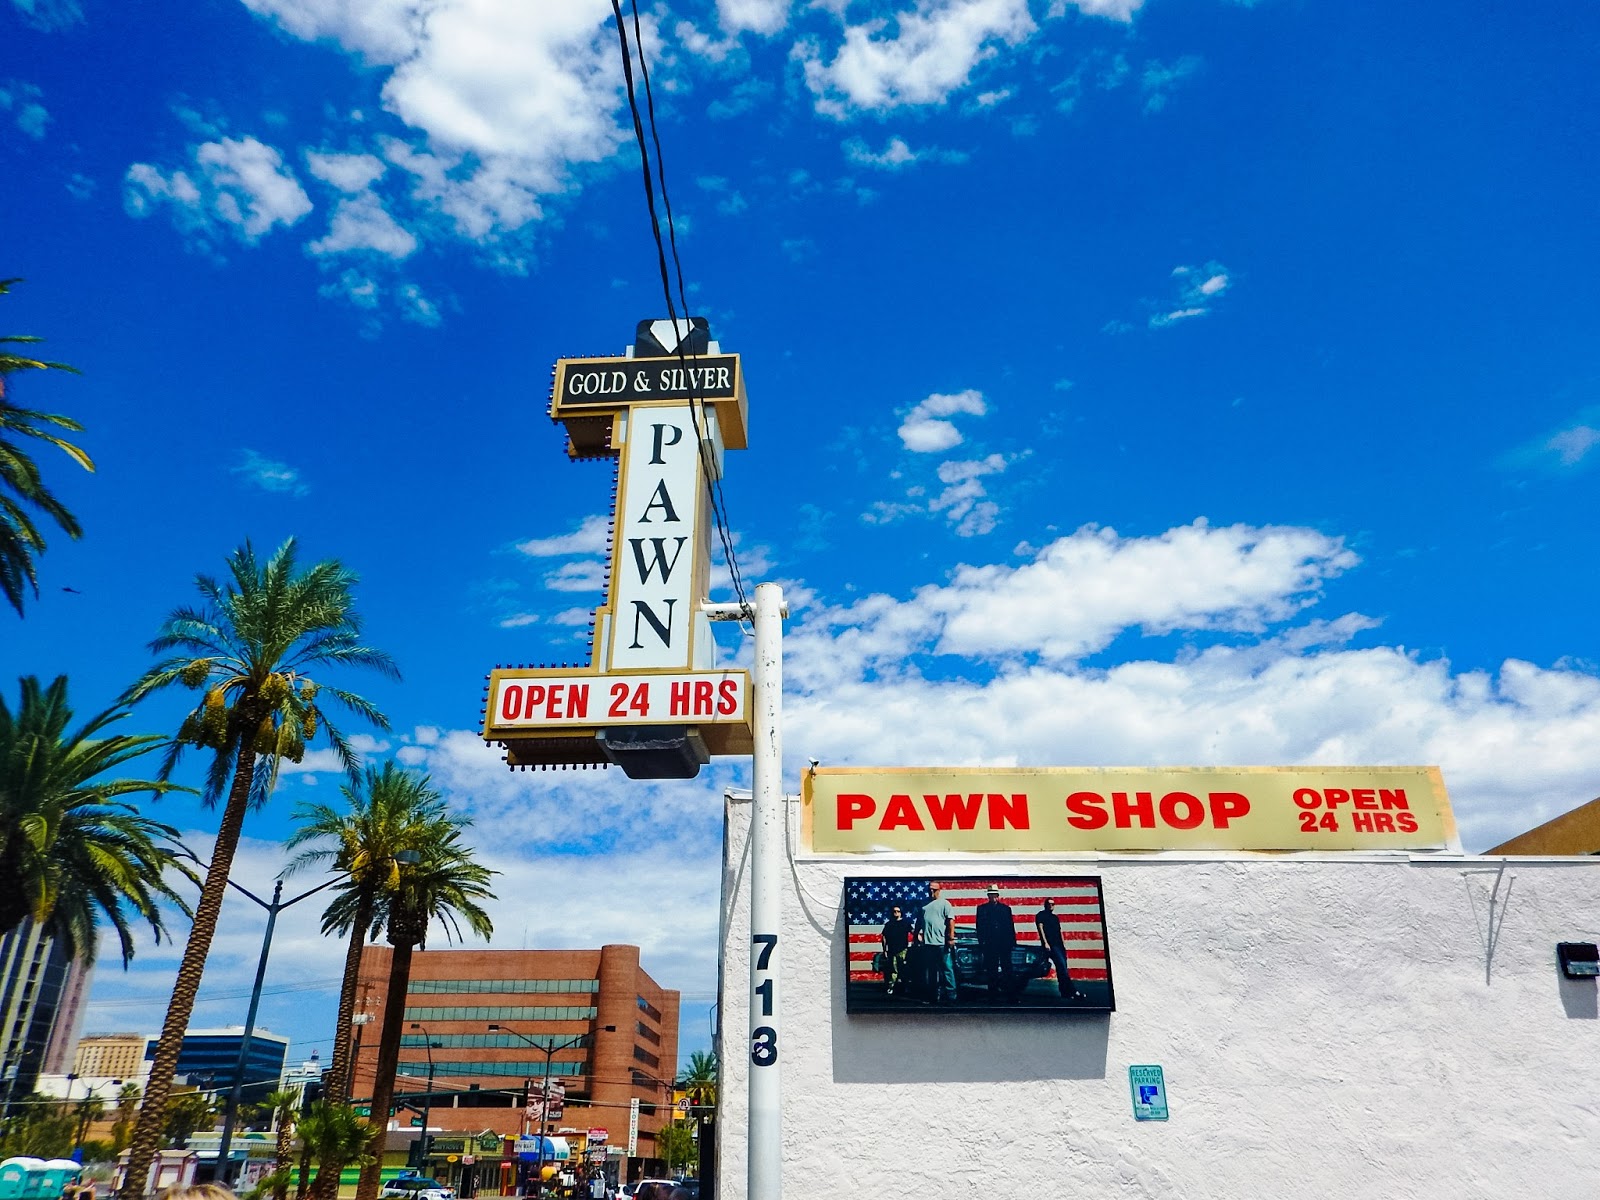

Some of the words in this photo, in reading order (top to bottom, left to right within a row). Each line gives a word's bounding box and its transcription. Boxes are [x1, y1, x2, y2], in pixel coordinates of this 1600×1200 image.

[568, 371, 627, 397] GOLD
[633, 370, 652, 392] &
[659, 366, 731, 392] SILVER
[628, 423, 688, 649] PAWN
[502, 684, 590, 721] OPEN
[608, 682, 650, 717] 24
[670, 679, 738, 716] HRS
[836, 793, 1031, 831] PAWN
[1066, 792, 1251, 830] SHOP
[1292, 788, 1410, 811] OPEN
[1299, 811, 1339, 833] 24
[1352, 811, 1419, 833] HRS
[750, 934, 779, 1068] 713
[1131, 1069, 1160, 1077] RESERVED
